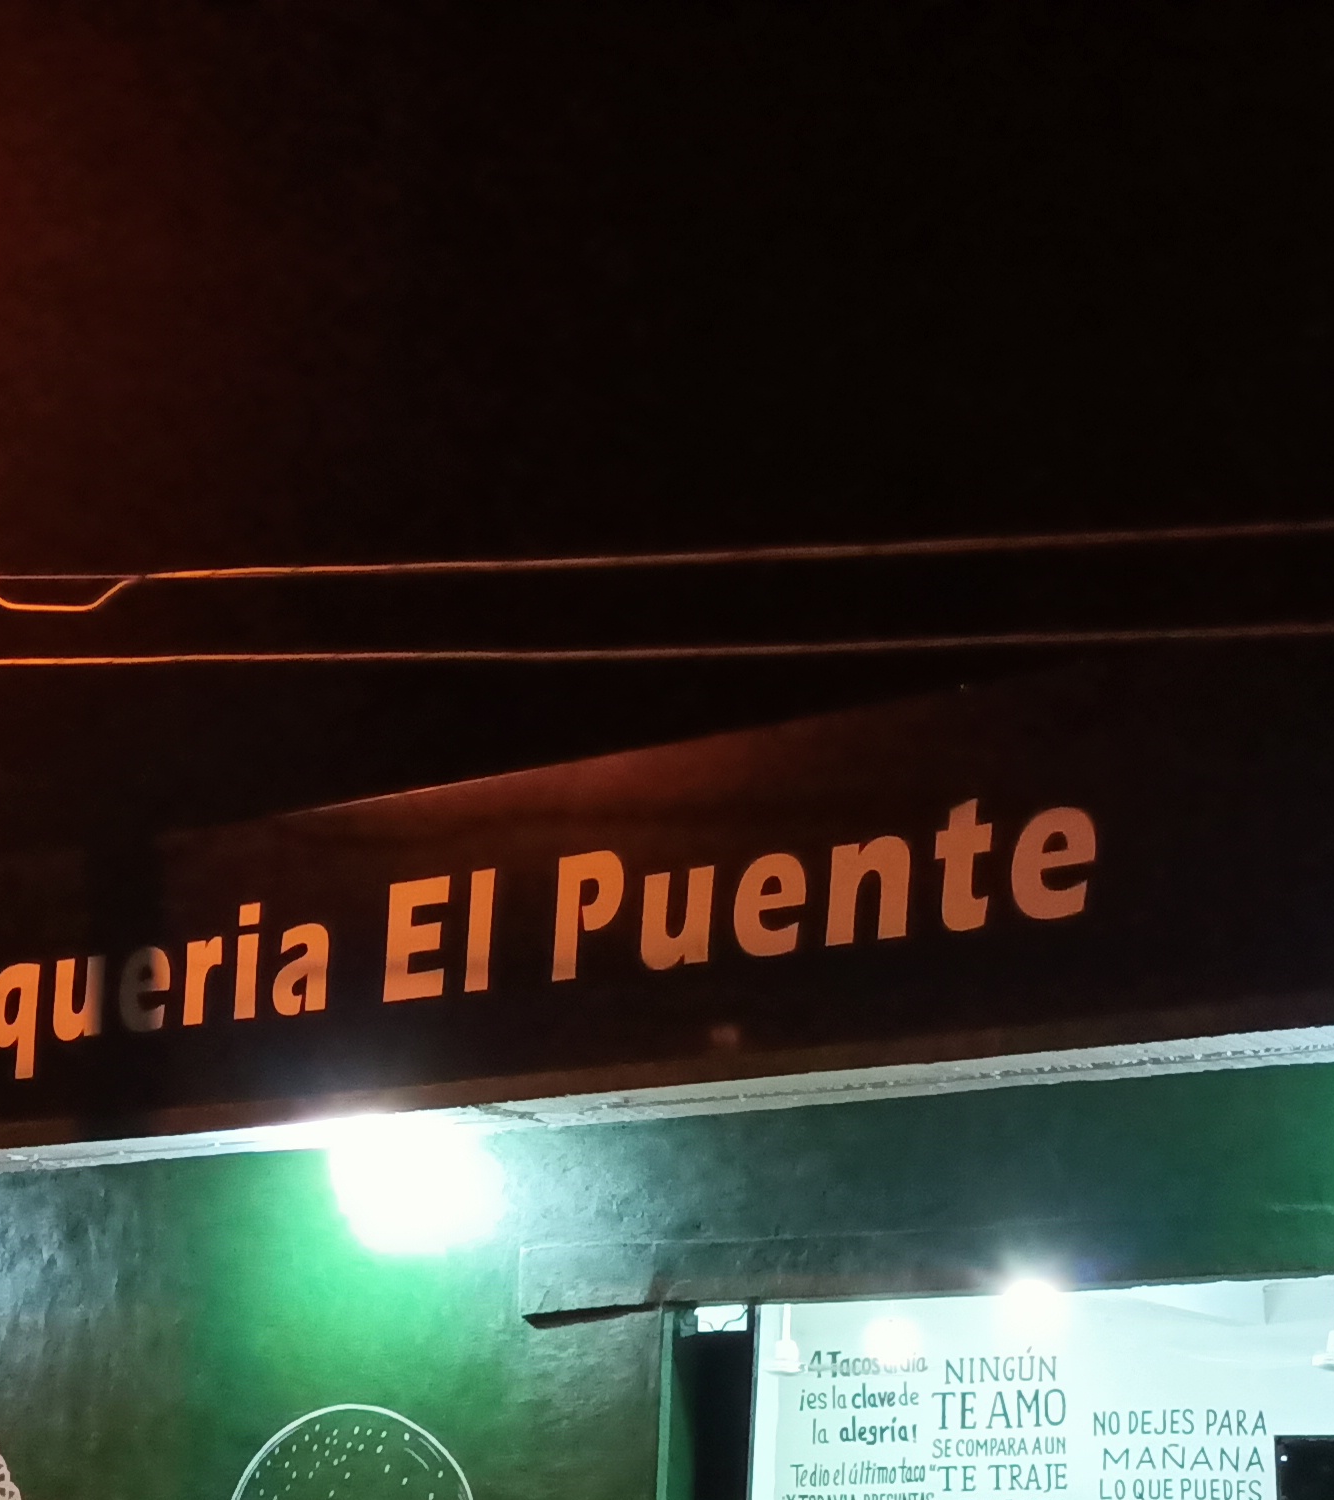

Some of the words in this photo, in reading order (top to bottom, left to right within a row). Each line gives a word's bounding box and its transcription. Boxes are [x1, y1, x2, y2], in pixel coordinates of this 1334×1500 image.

[383, 868, 496, 1003] El
[551, 798, 1097, 982] Puente
[826, 1351, 881, 1378] Tacos
[944, 1346, 1057, 1385] NINGÚN
[832, 1385, 847, 1410] la
[851, 1383, 896, 1409] clave
[898, 1381, 919, 1406] de
[931, 1391, 977, 1430] TE
[985, 1388, 1066, 1429] AMO
[812, 1418, 829, 1445] la
[839, 1415, 918, 1446] alegría!
[1093, 1410, 1121, 1437] NO
[1128, 1408, 1195, 1435] DEJES
[1206, 1408, 1267, 1436] PARA
[932, 1438, 952, 1459] SE
[955, 1437, 1029, 1457] COMPARA
[1031, 1436, 1043, 1455] A
[1044, 1436, 1067, 1455] UN
[1102, 1443, 1265, 1473] MAÑANA
[789, 1464, 808, 1488] Te
[809, 1462, 830, 1487] dio
[833, 1461, 845, 1486] el
[848, 1460, 897, 1485] último
[898, 1457, 926, 1484] taco
[988, 1463, 1068, 1493] TRAJE
[1099, 1478, 1126, 1500] LO
[1132, 1478, 1174, 1500] QUE
